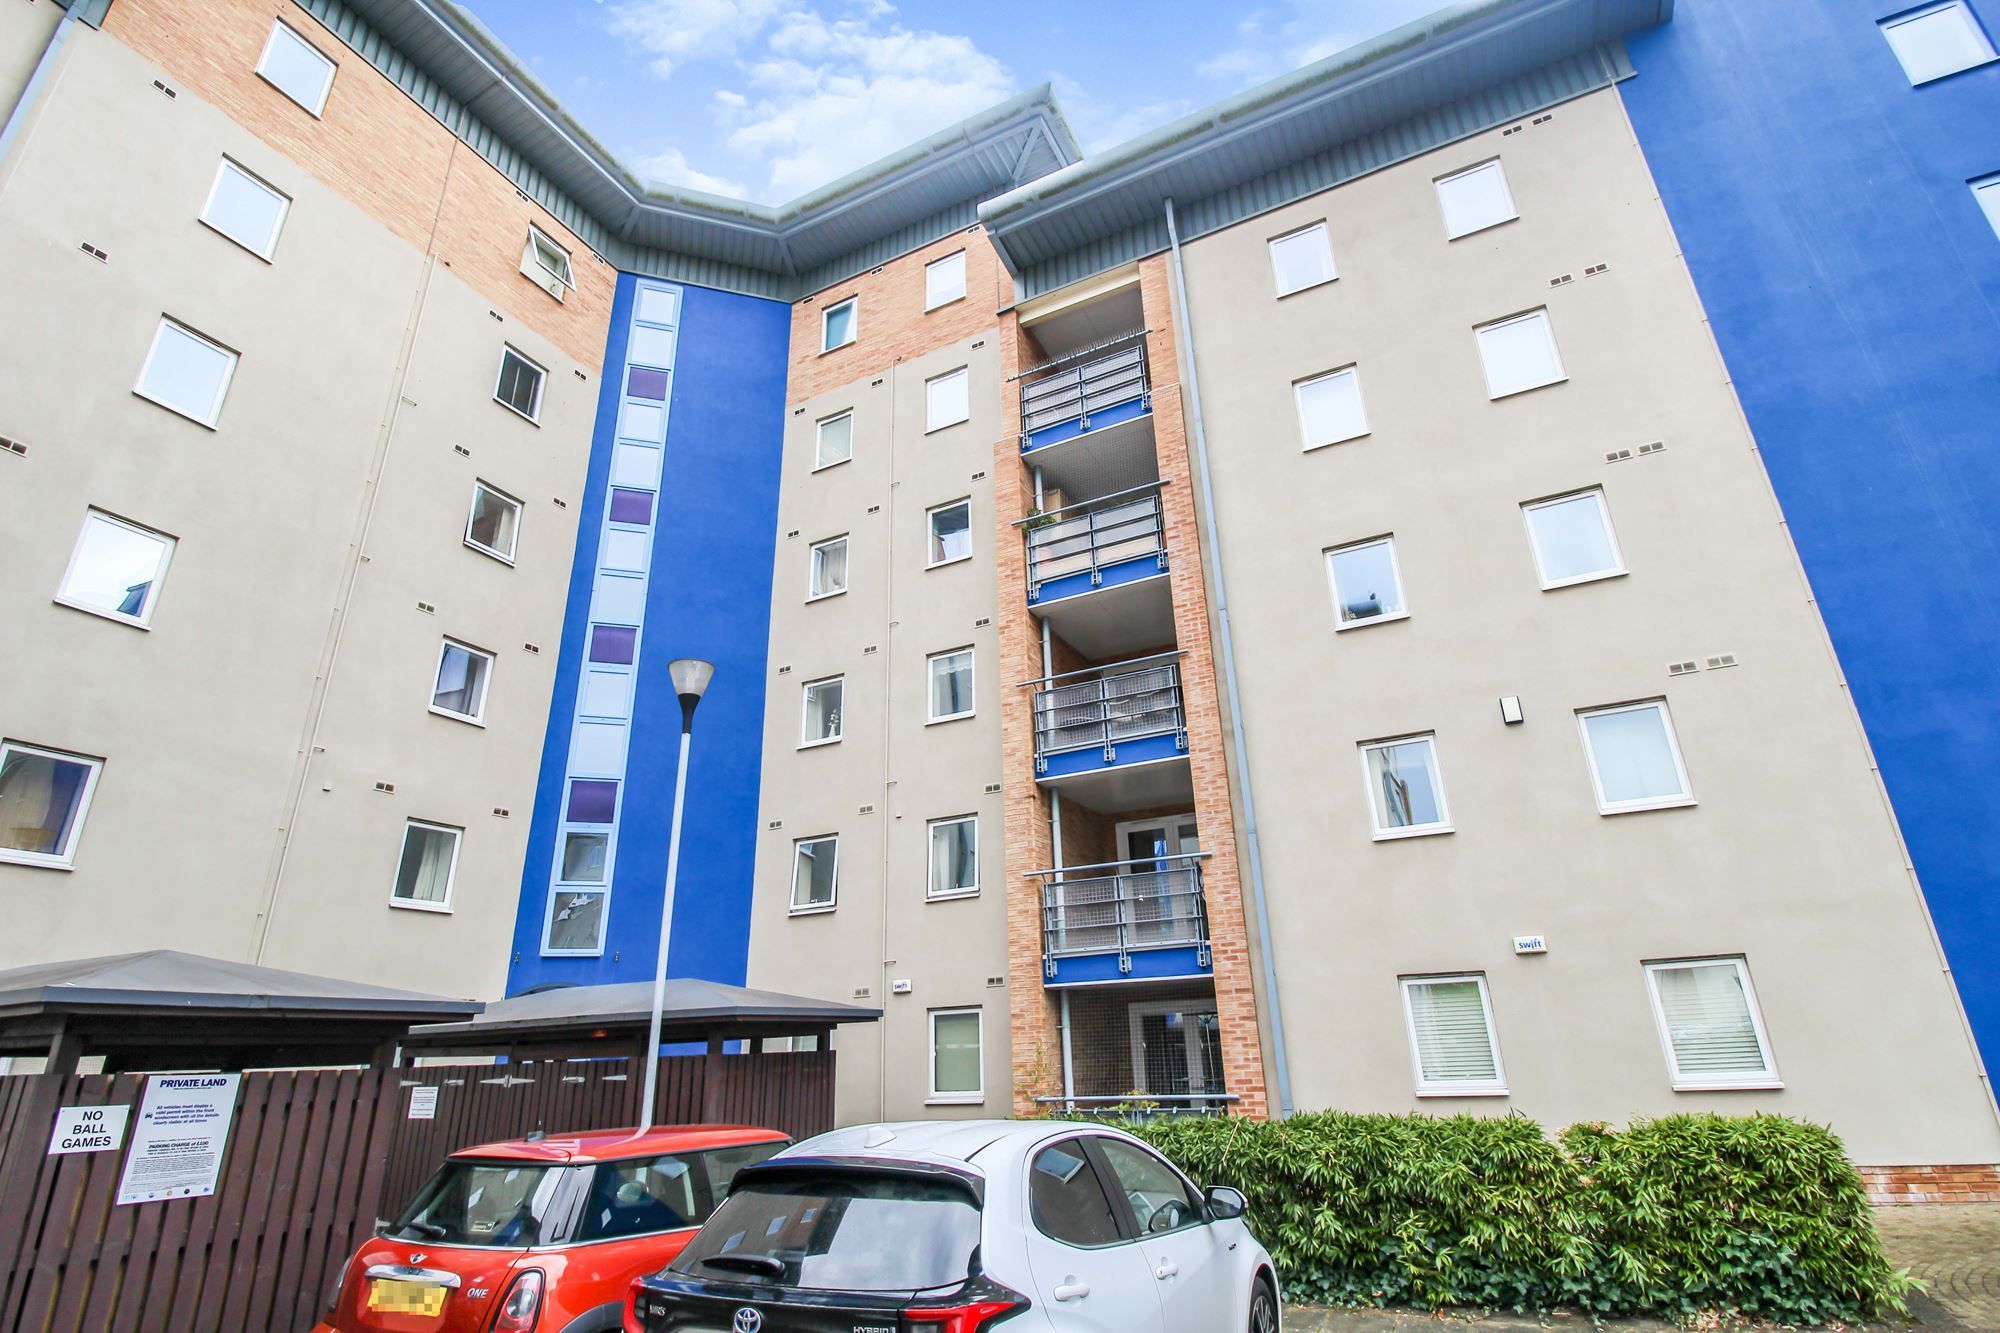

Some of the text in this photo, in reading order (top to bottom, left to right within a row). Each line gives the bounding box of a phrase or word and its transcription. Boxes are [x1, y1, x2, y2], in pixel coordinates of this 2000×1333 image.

[1518, 938, 1541, 948] swift
[160, 1078, 227, 1088] PRIVATE LAND
[82, 1110, 103, 1121] NO
[73, 1124, 106, 1134] BALL
[62, 1136, 111, 1148] GAMES
[467, 1288, 488, 1298] ONE
